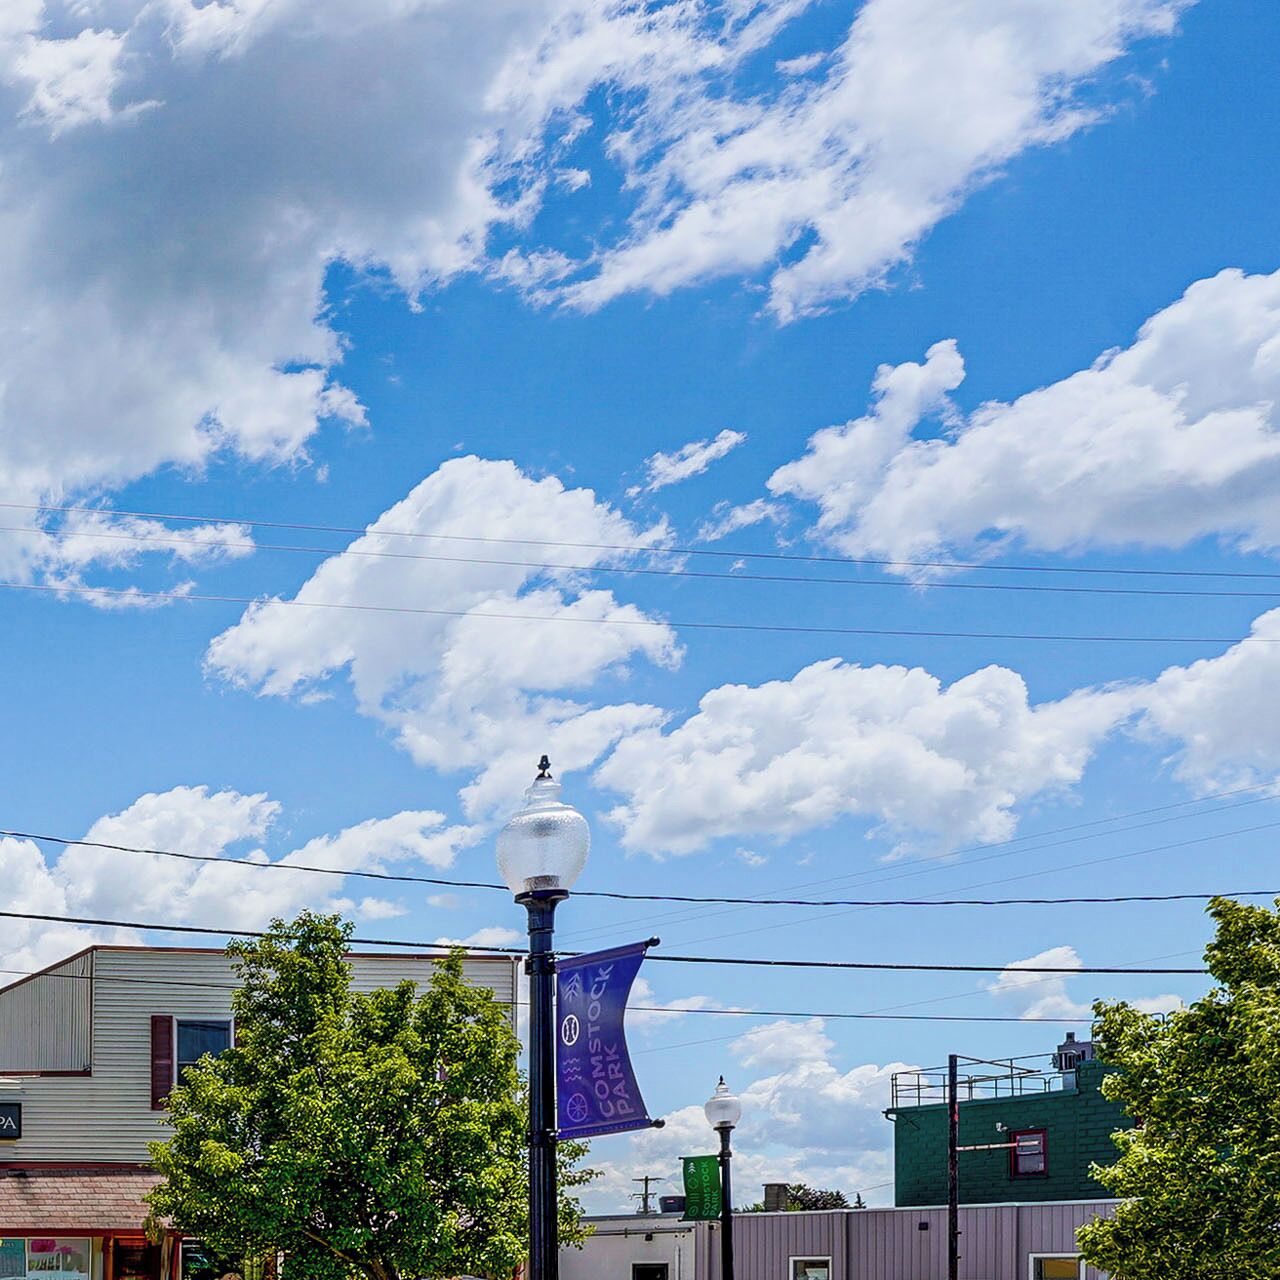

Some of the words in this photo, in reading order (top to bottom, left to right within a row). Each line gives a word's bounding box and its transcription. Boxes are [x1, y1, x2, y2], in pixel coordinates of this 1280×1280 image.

[588, 963, 615, 1118] COMSTOCK
[603, 1042, 635, 1116] PARK
[701, 1160, 711, 1217] COMSTOCK
[710, 1189, 719, 1217] PARK
